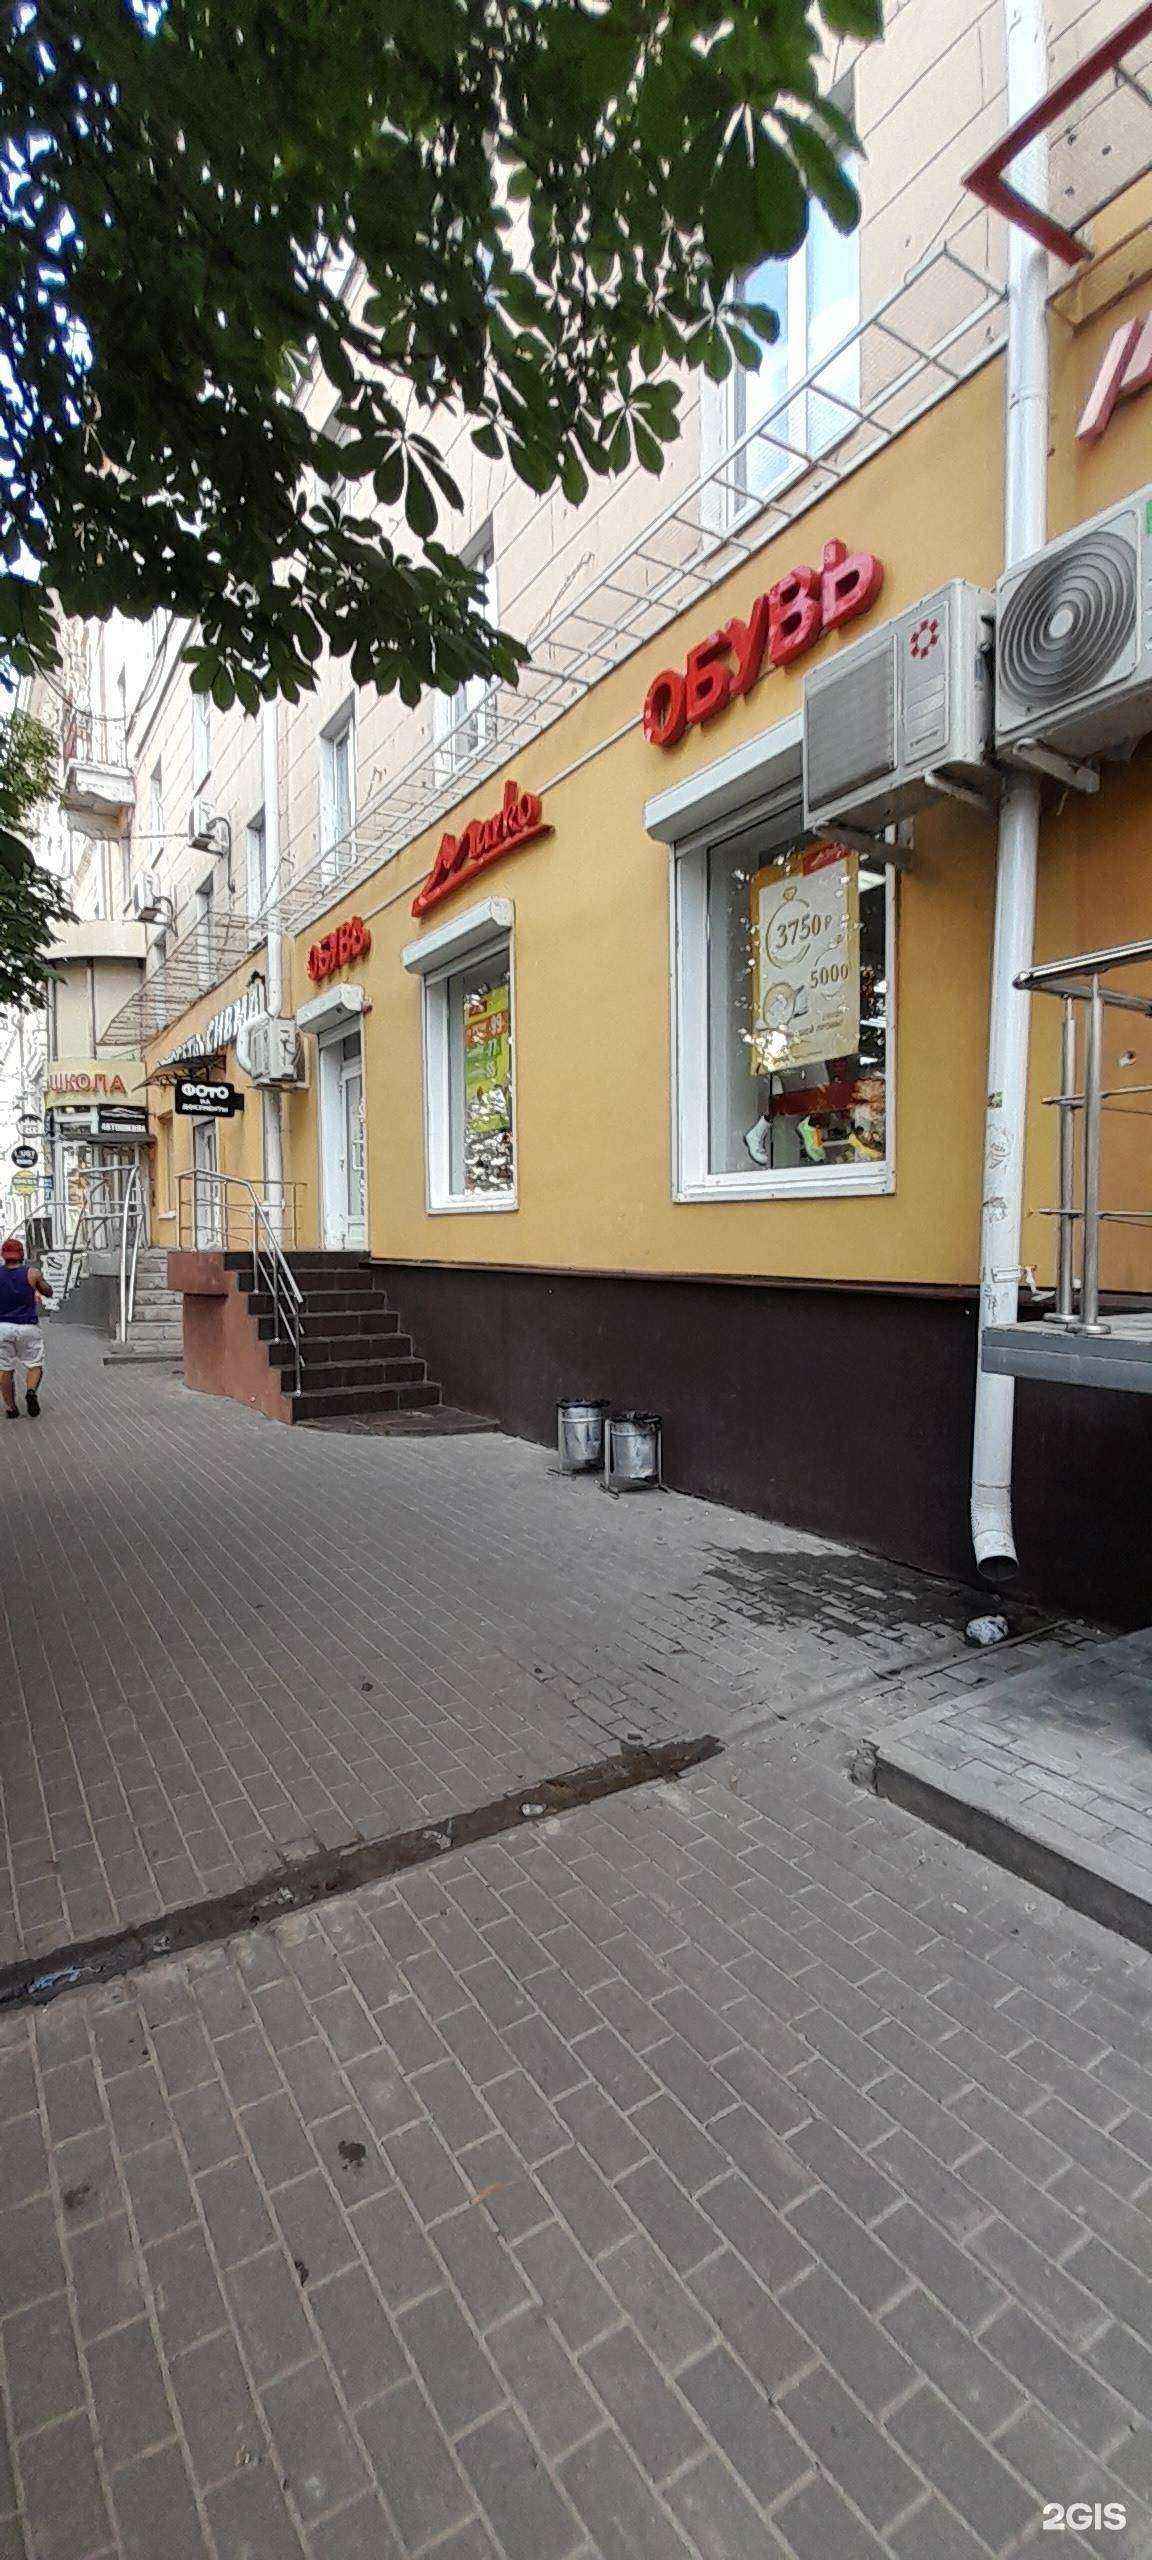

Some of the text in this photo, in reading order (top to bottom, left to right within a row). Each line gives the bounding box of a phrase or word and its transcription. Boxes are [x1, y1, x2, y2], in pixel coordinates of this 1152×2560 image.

[643, 537, 885, 747] ОБУВЬ
[308, 916, 372, 982] ОБУВЬ
[48, 1072, 127, 1095] ШКОЛА
[181, 1083, 230, 1100] ФОТО
